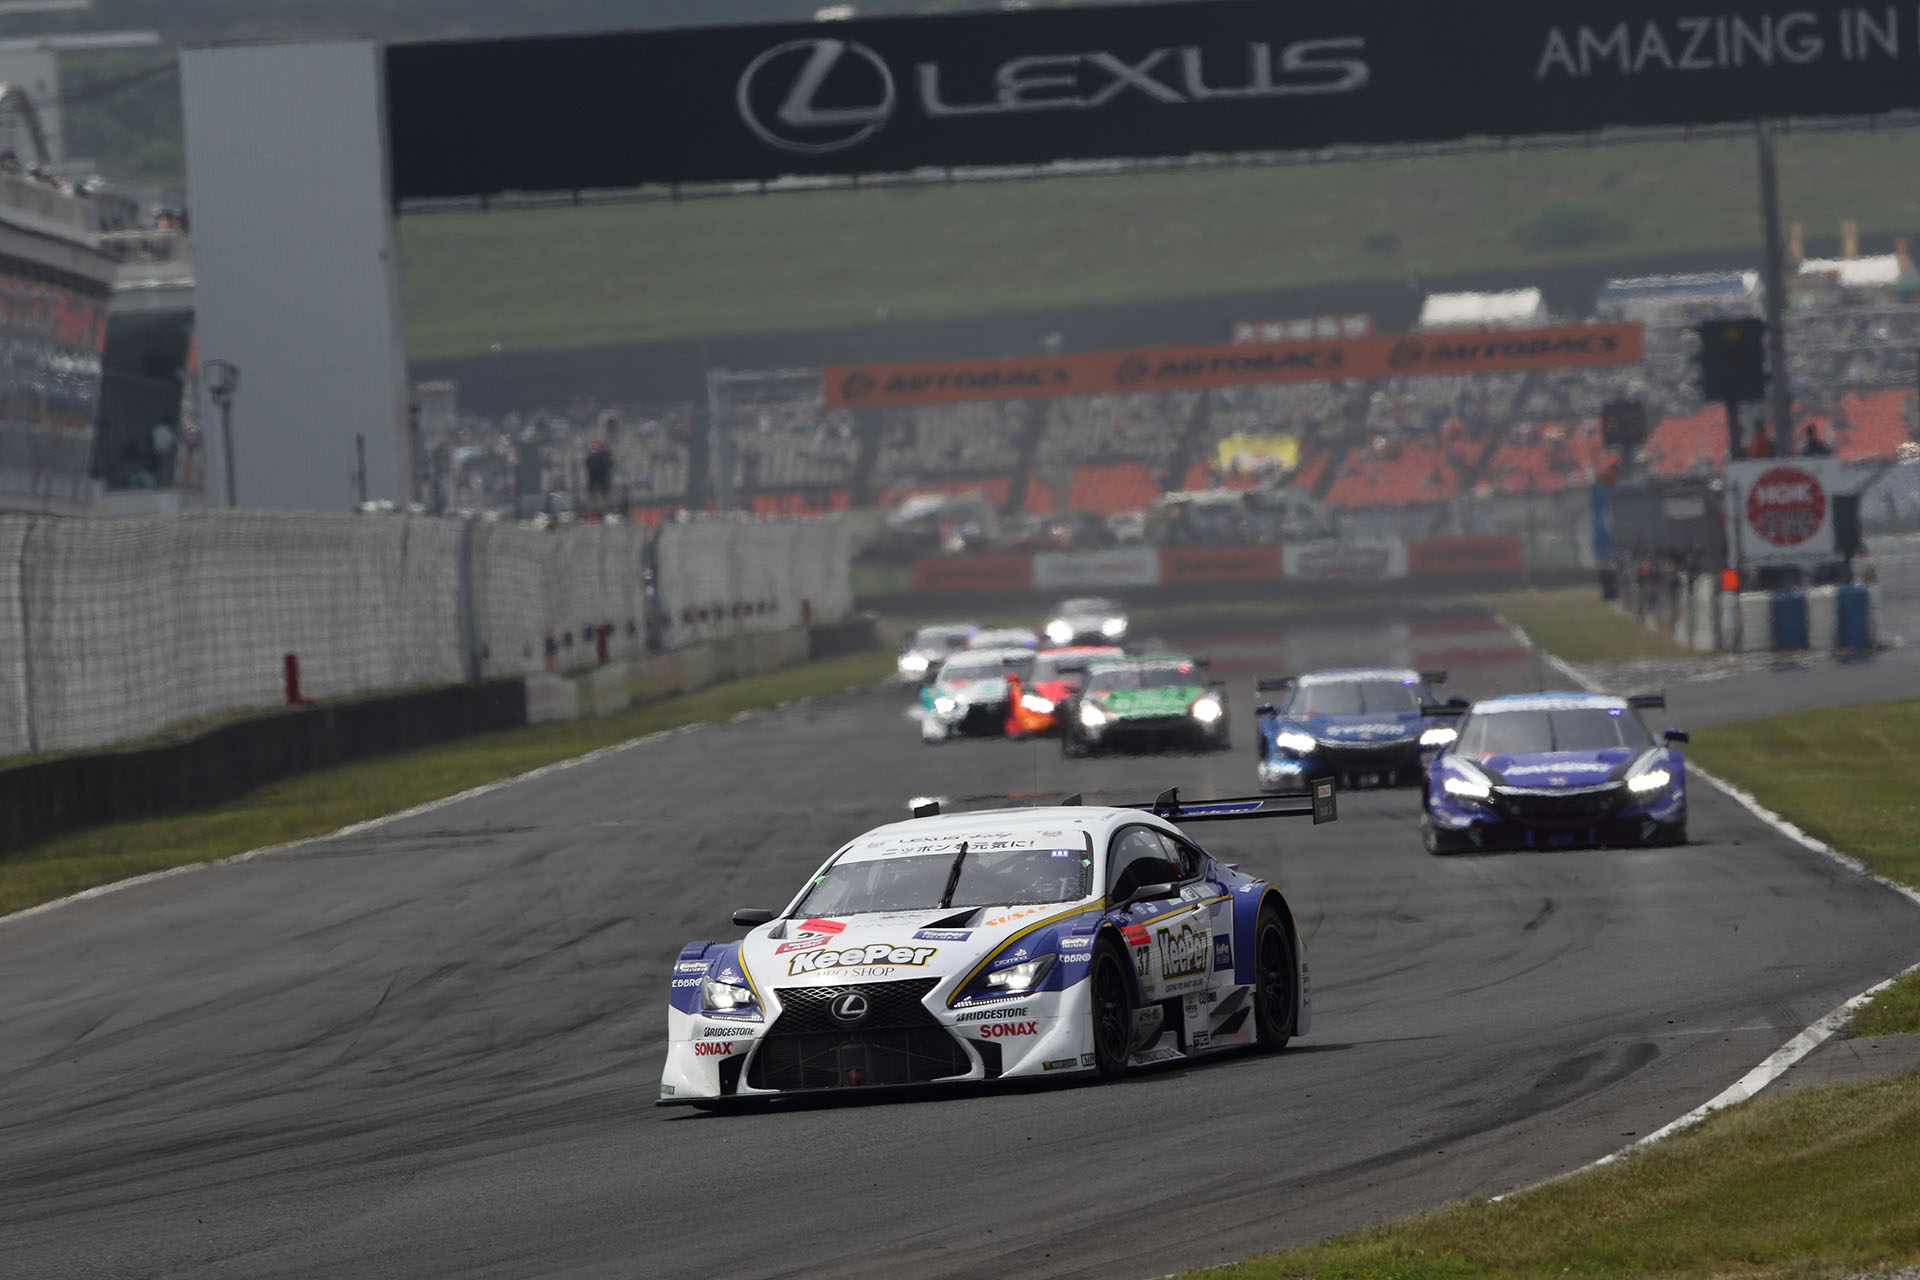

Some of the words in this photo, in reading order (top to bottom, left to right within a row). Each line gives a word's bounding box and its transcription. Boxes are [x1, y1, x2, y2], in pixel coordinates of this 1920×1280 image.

[1534, 11, 1824, 79] AMAZING
[1839, 5, 1900, 62] IN
[915, 37, 1372, 118] LEXUS
[1154, 348, 1342, 378] AUTOBACS
[1430, 334, 1619, 363] AUTOBACS
[883, 366, 1072, 395] AUTOBACS
[788, 944, 937, 977] KeePer
[1137, 946, 1150, 977] 37
[1158, 923, 1208, 980] KeePer
[853, 967, 895, 977] SHOP
[956, 1007, 1028, 1022] BRIDGESTONE
[704, 1027, 755, 1037] BRIDGESTONE
[980, 1021, 1038, 1038] SONAX
[694, 1041, 732, 1056] SONAX
